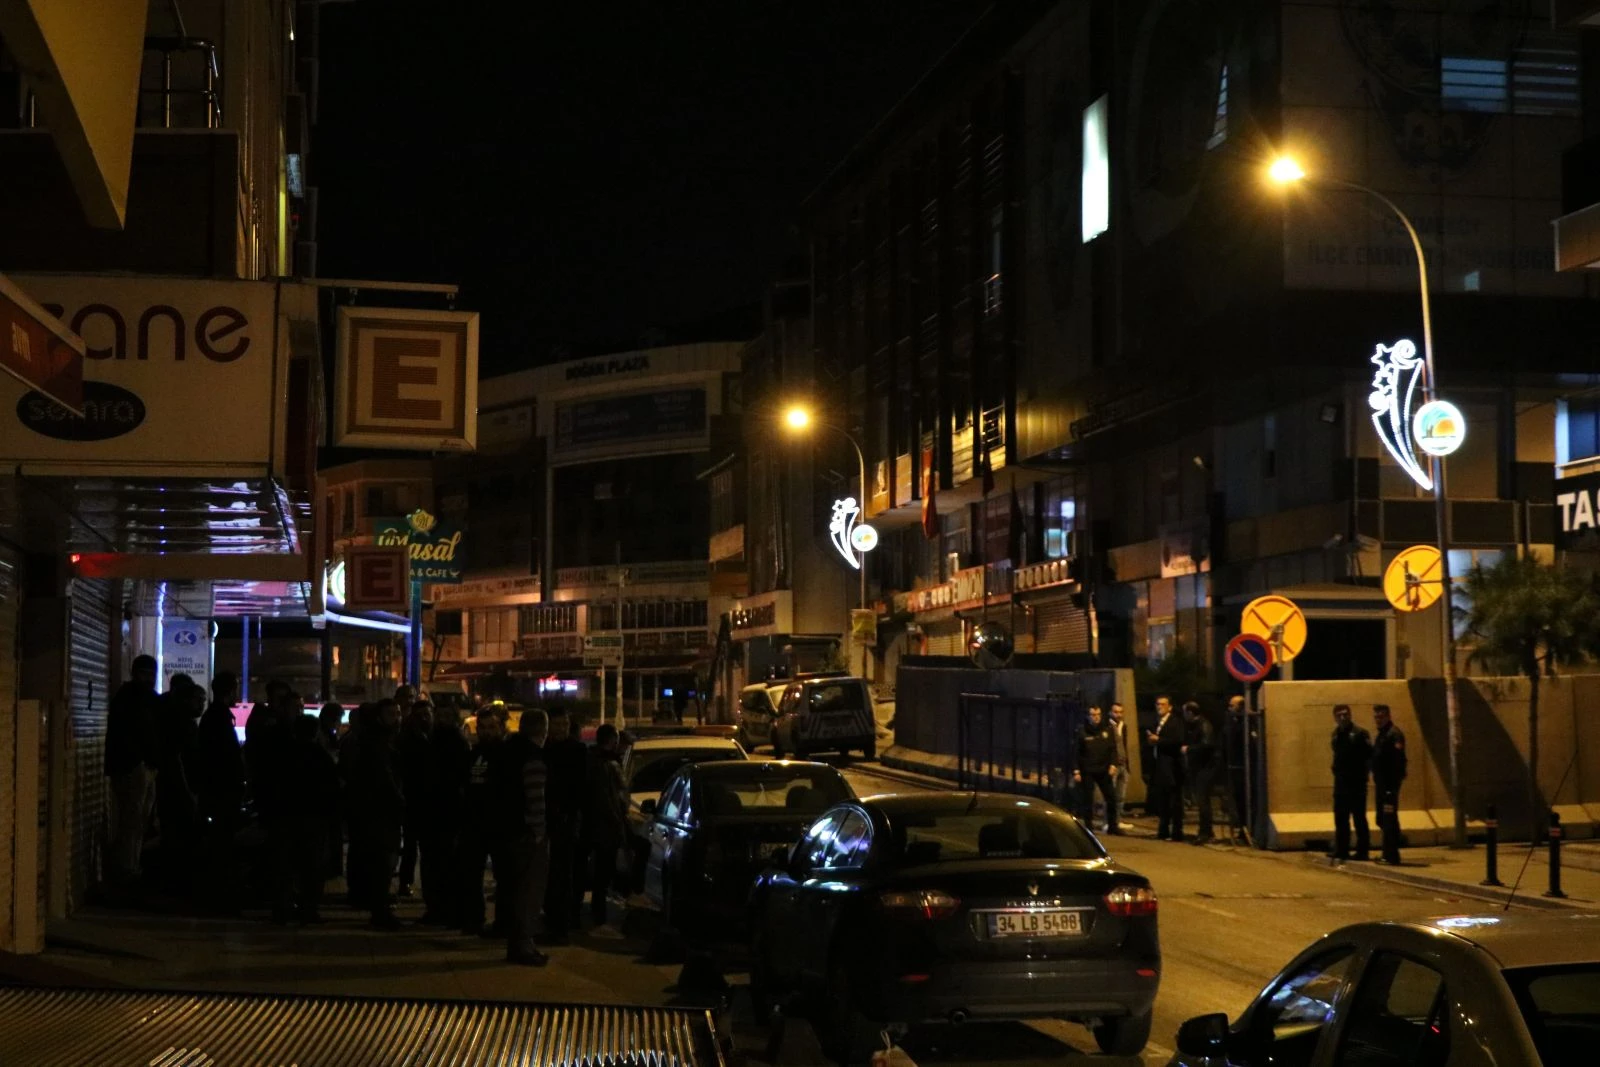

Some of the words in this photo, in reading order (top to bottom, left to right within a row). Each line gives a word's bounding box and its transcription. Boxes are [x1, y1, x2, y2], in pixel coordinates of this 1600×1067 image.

[371, 337, 442, 421] E
[1557, 488, 1600, 532] TA
[999, 916, 1015, 931] 34
[1021, 915, 1038, 930] LB
[1043, 914, 1077, 930] 5488
